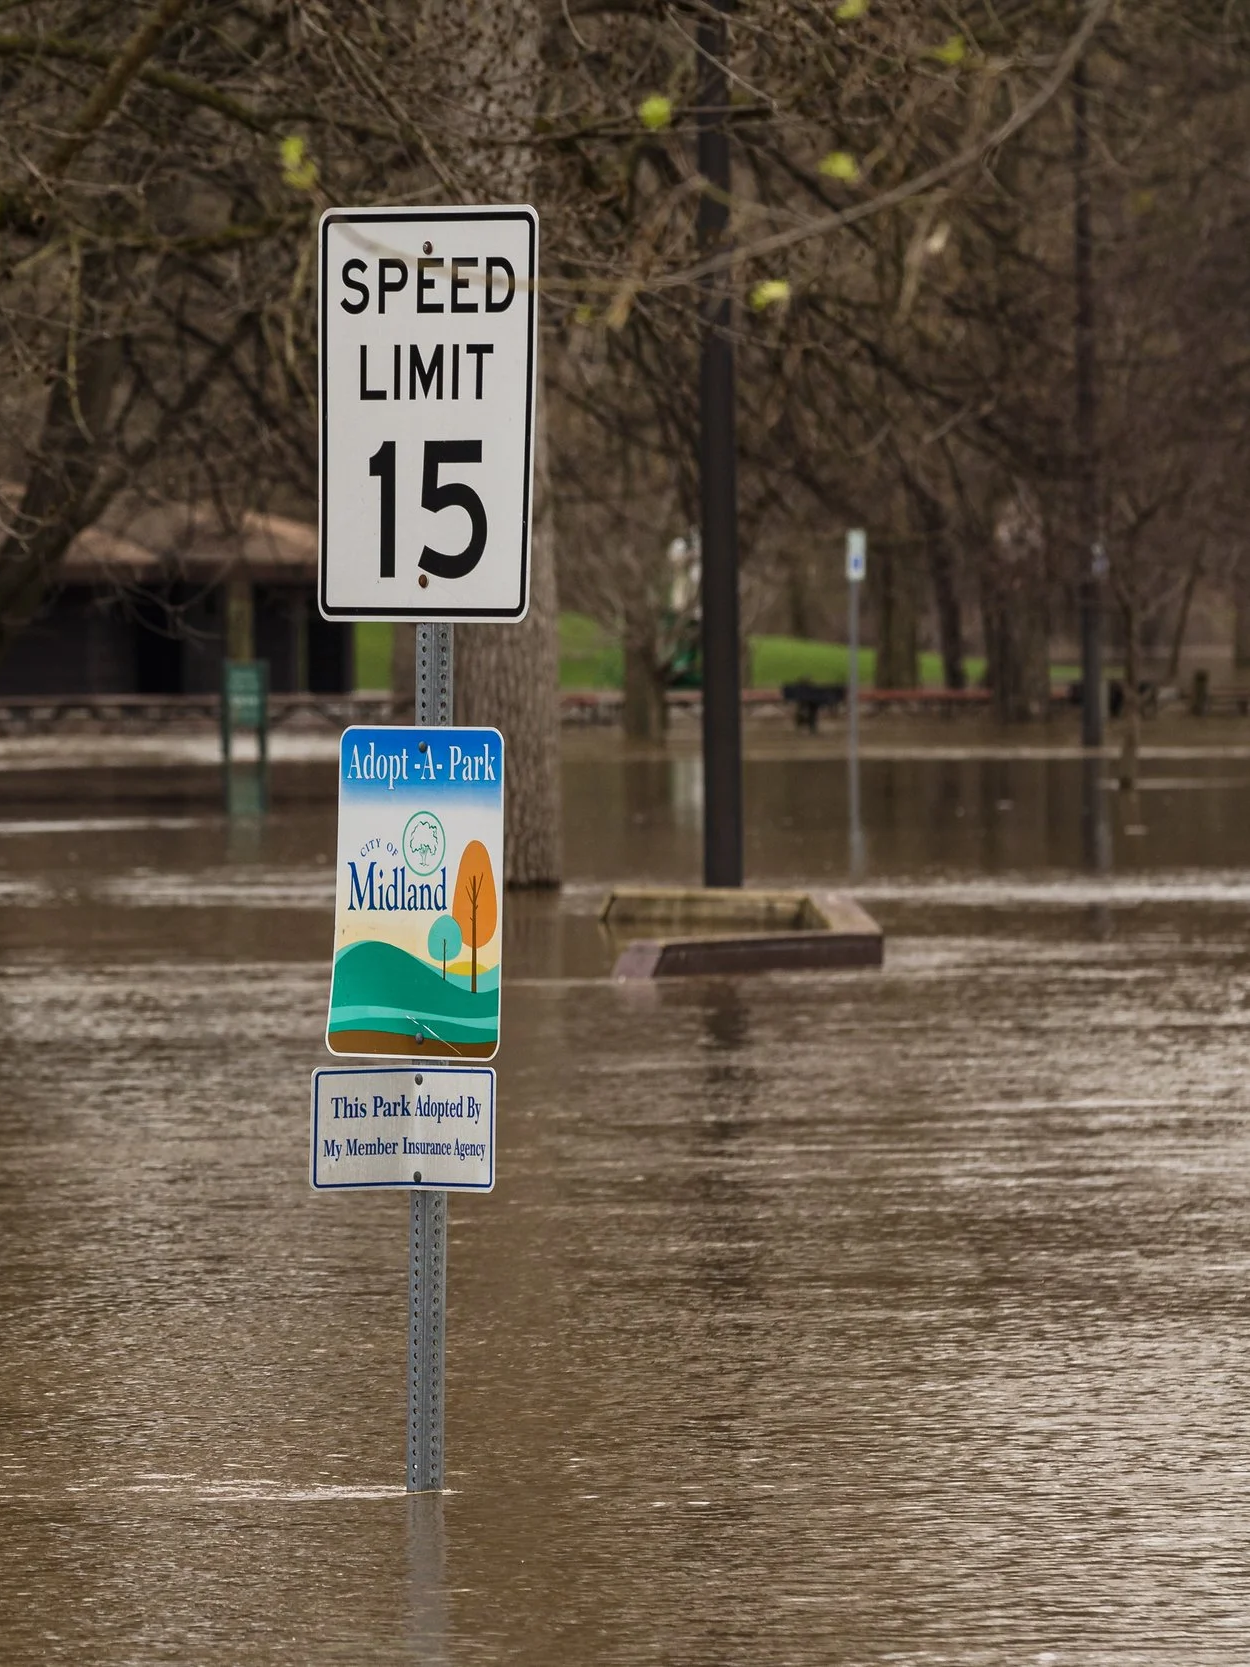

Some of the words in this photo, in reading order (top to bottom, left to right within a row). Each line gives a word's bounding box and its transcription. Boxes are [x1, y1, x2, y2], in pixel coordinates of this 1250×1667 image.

[340, 257, 516, 315] SPEED
[360, 344, 494, 401] LIMIT
[369, 440, 487, 579] 15
[347, 742, 409, 790] Adopt
[449, 743, 496, 781] Park
[360, 838, 382, 857] CITY
[386, 842, 399, 857] OF
[347, 861, 448, 911] Midland
[331, 1096, 368, 1119] This
[372, 1094, 411, 1118] Park
[414, 1095, 463, 1123] Adopted
[466, 1096, 482, 1124] By
[323, 1139, 342, 1161] My
[346, 1137, 398, 1156] Member
[402, 1136, 451, 1156] Insurance
[453, 1138, 486, 1161] Agency
